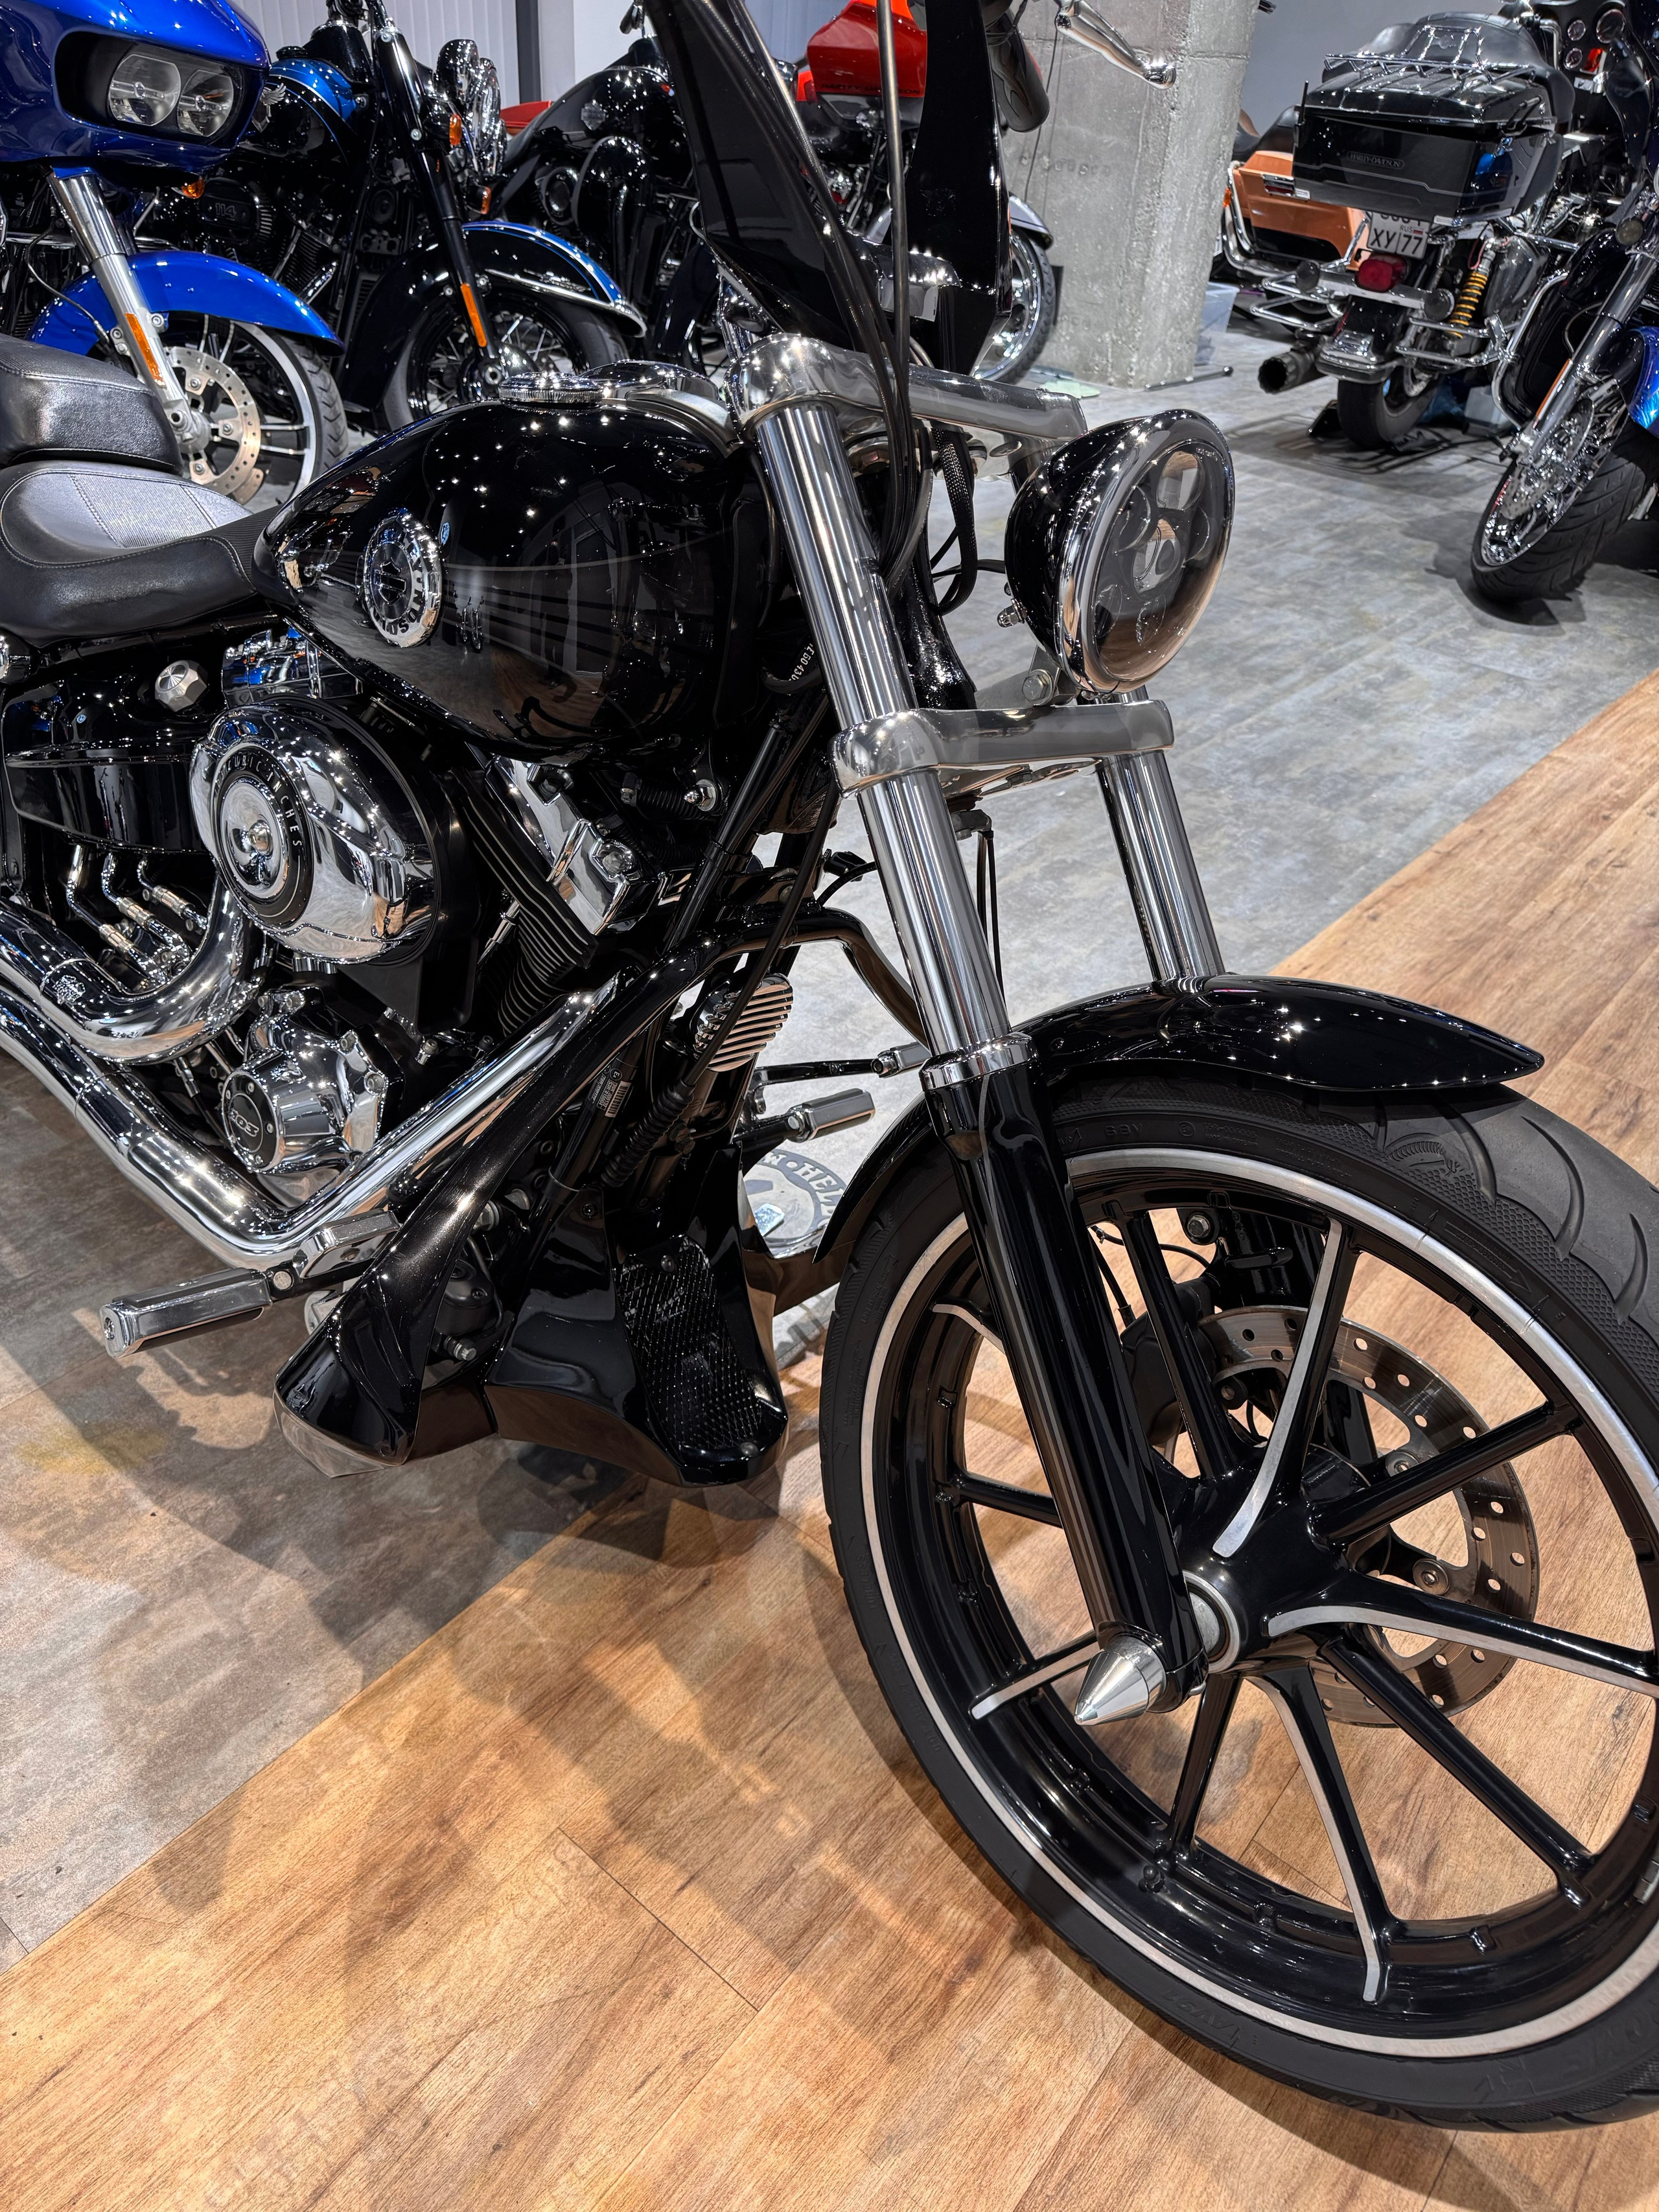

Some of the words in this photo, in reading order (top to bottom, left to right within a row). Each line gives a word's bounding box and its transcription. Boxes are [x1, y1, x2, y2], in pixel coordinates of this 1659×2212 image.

[215, 202, 237, 218] 114
[1400, 224, 1413, 233] RUS
[1401, 235, 1423, 255] 77
[227, 756, 262, 774] CUBIC
[266, 771, 303, 846] INCHES
[229, 1107, 260, 1137] 103
[1457, 1231, 1476, 1248] WHEEL
[1478, 1247, 1507, 1271] ROTATION
[855, 1553, 878, 1611] TUBELESS
